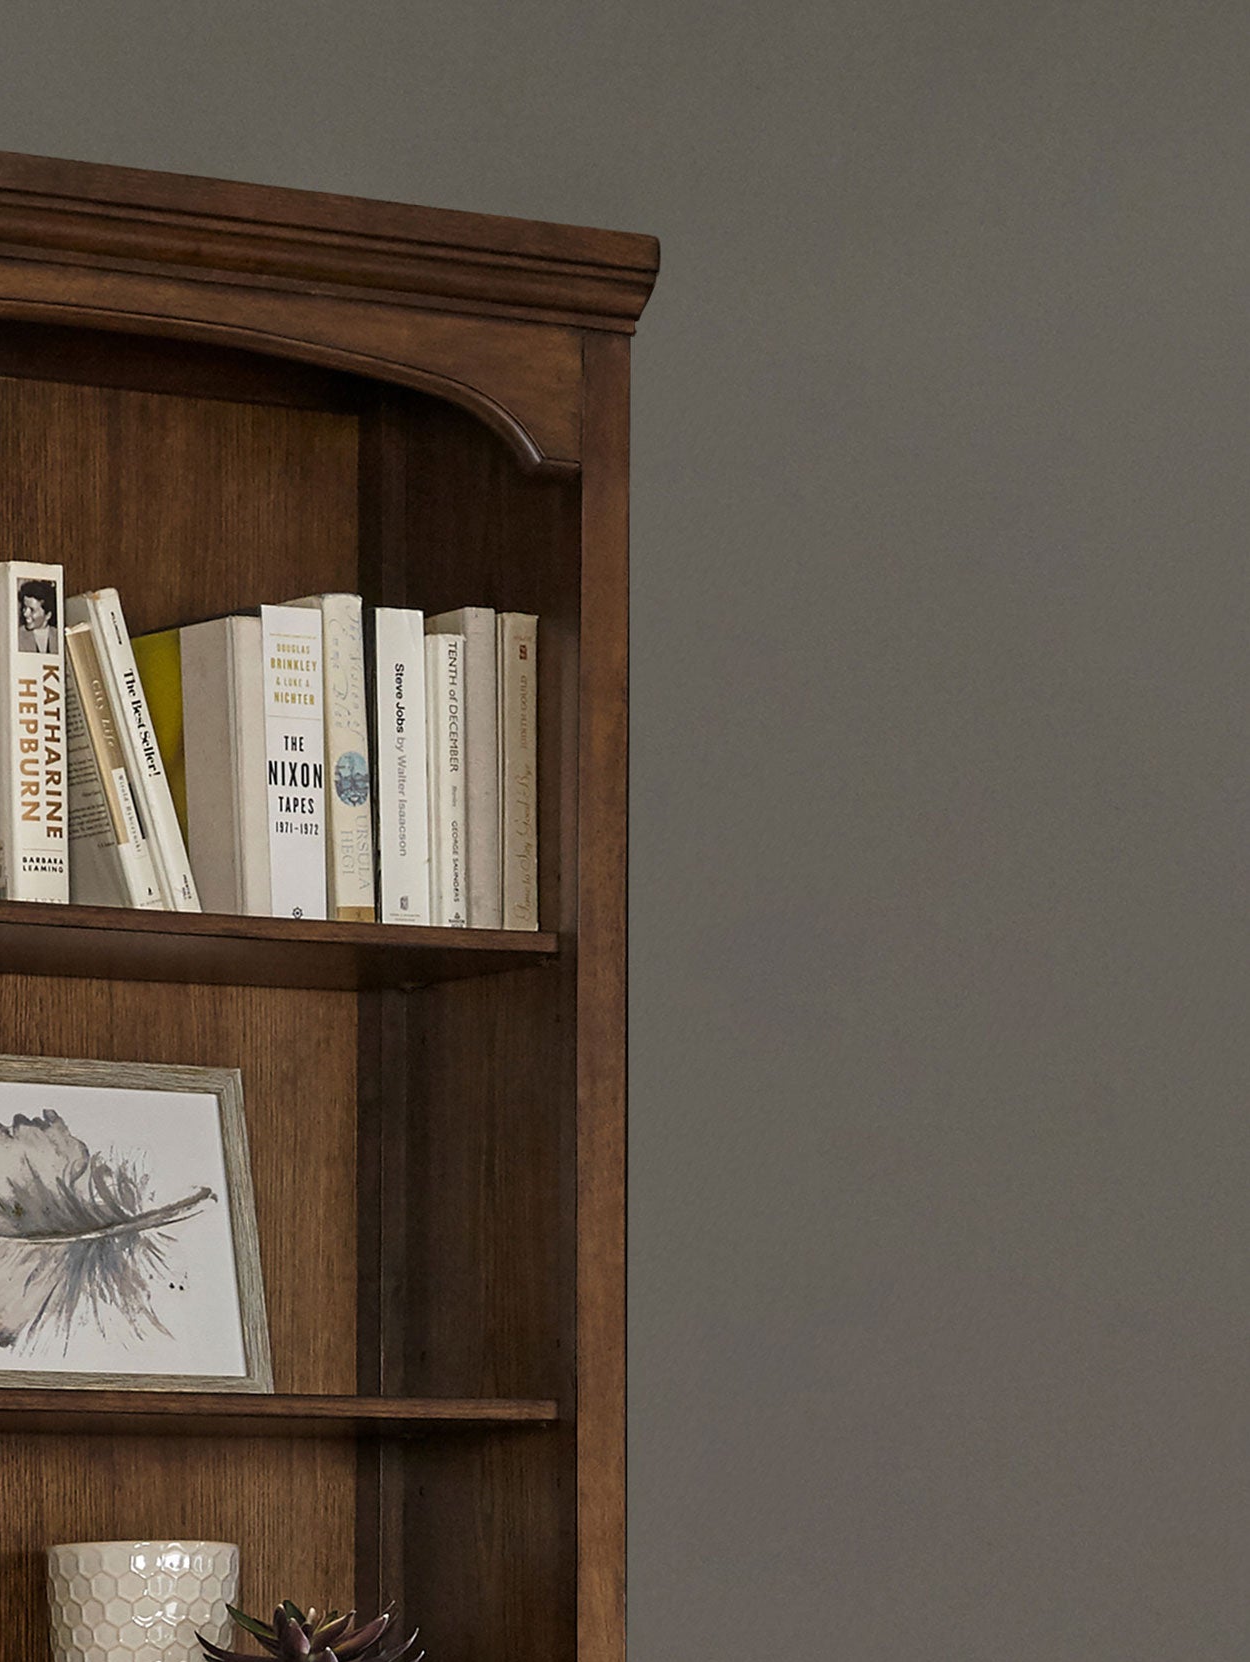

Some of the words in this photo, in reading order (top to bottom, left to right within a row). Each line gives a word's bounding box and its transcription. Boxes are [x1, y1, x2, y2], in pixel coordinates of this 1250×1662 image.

[270, 657, 317, 672] BRINKLEY
[395, 663, 405, 699] Steve
[448, 642, 458, 686] TENTH
[122, 668, 138, 698] The
[274, 691, 316, 705] NICHTER
[448, 689, 458, 703] of
[519, 674, 527, 711] GOULD
[91, 678, 105, 711] City
[101, 718, 115, 748] Life
[130, 699, 147, 729] Best
[395, 702, 406, 734] Jobs
[18, 678, 41, 822] HEPBURN
[42, 664, 63, 839] KATHARINE
[138, 729, 161, 778] Seller!
[283, 736, 305, 752] THE
[395, 736, 407, 752] by
[449, 703, 458, 772] DECEMBER
[268, 760, 323, 789] NIXON
[397, 755, 407, 796] Walter
[278, 796, 315, 815] TAPES
[398, 799, 408, 857] Isaacson
[22, 856, 64, 865] BARBARA
[22, 865, 64, 874] LEAMING
[340, 830, 355, 877] HEGI
[356, 815, 370, 890] URSULA
